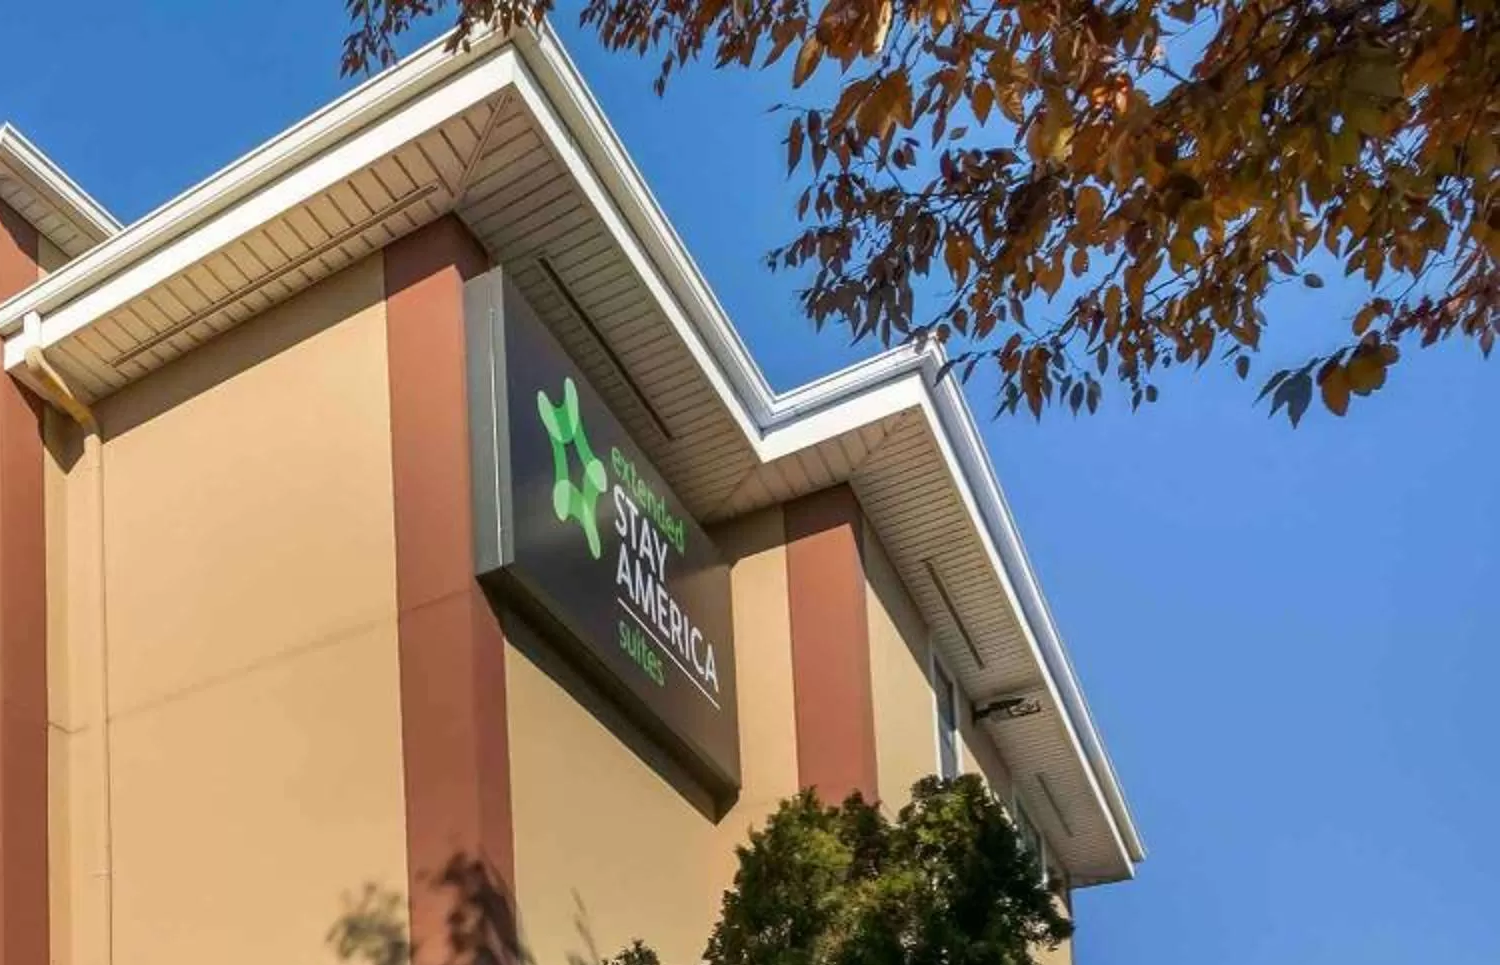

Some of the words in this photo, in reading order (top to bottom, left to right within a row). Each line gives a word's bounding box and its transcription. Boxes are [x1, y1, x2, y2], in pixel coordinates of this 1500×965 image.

[612, 446, 685, 555] extended
[613, 485, 668, 582] STAY
[616, 544, 719, 692] AMERICA
[619, 619, 664, 687] suites
